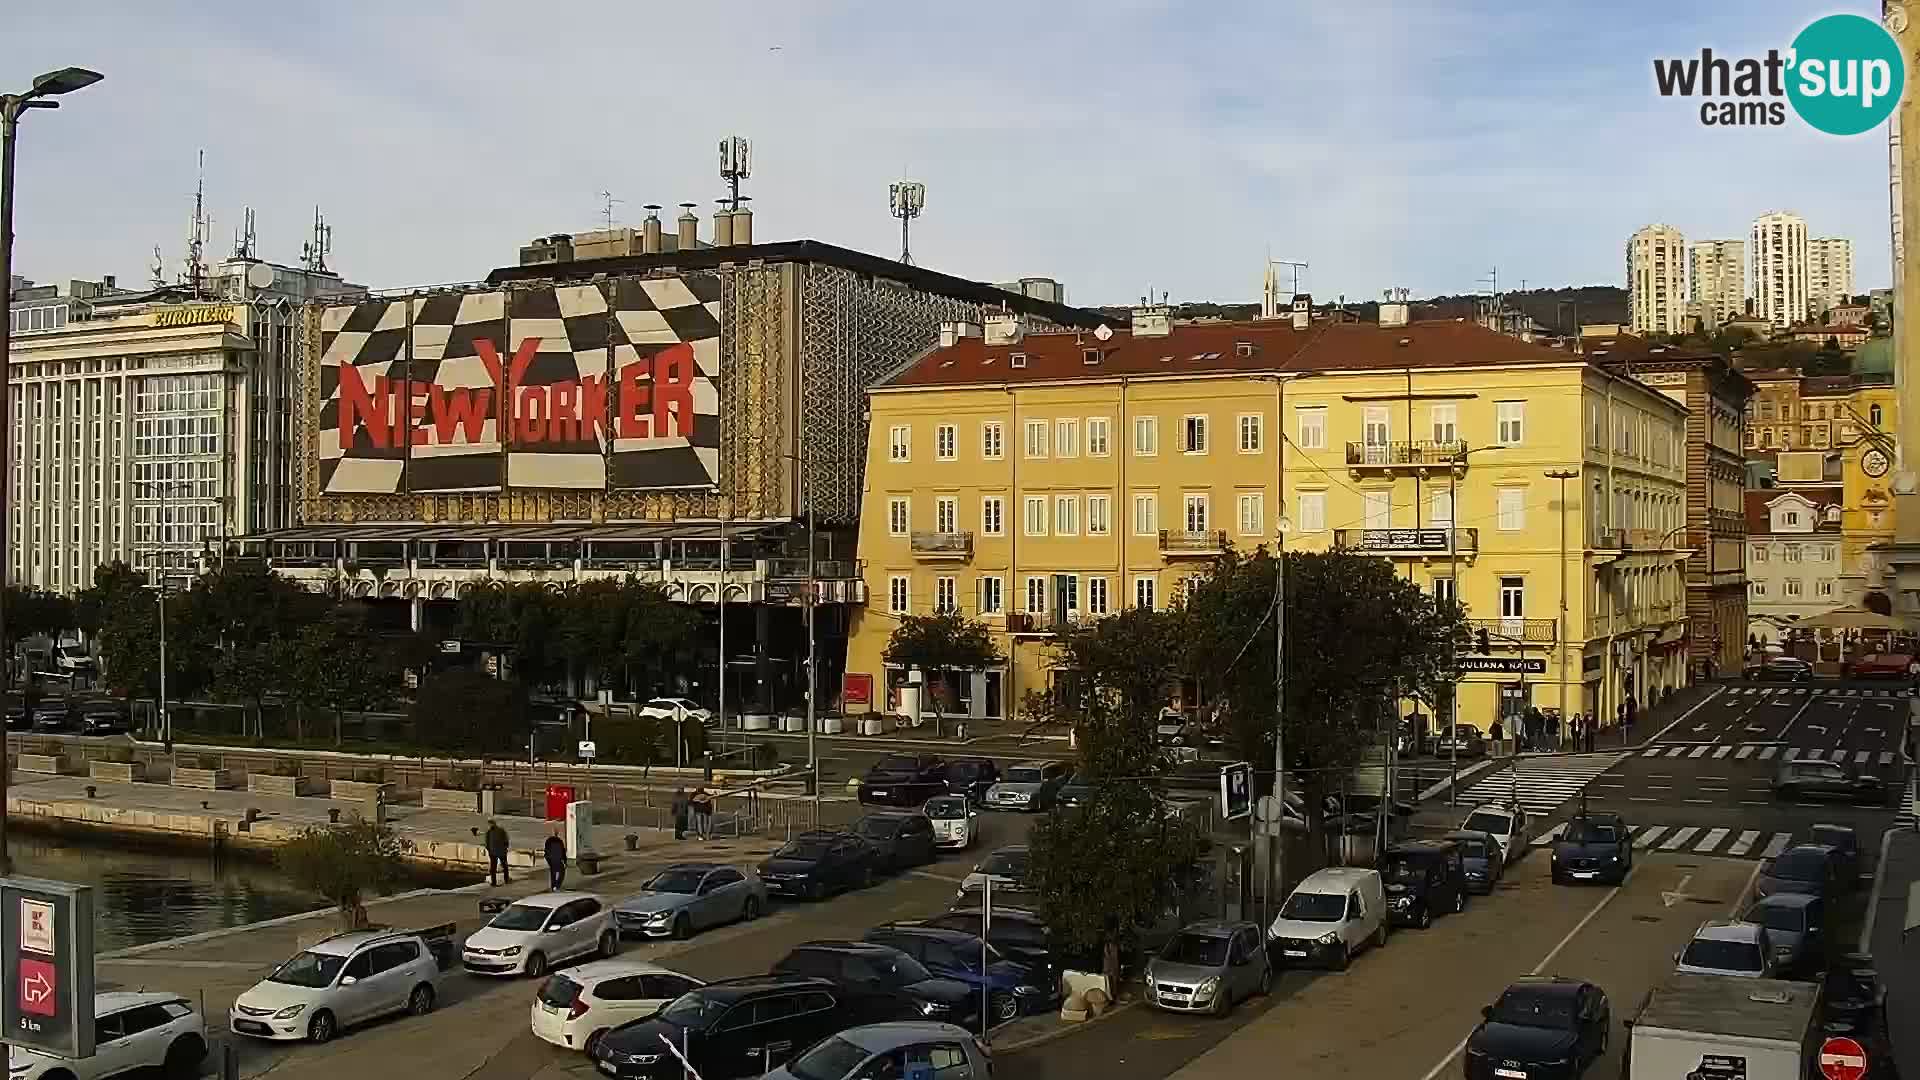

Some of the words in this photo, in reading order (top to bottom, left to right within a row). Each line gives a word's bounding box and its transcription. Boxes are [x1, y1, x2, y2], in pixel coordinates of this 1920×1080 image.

[1459, 661, 1505, 669] JULIANA
[1509, 662, 1541, 670] NAILS
[21, 1018, 27, 1029] 5
[28, 1020, 40, 1032] km
